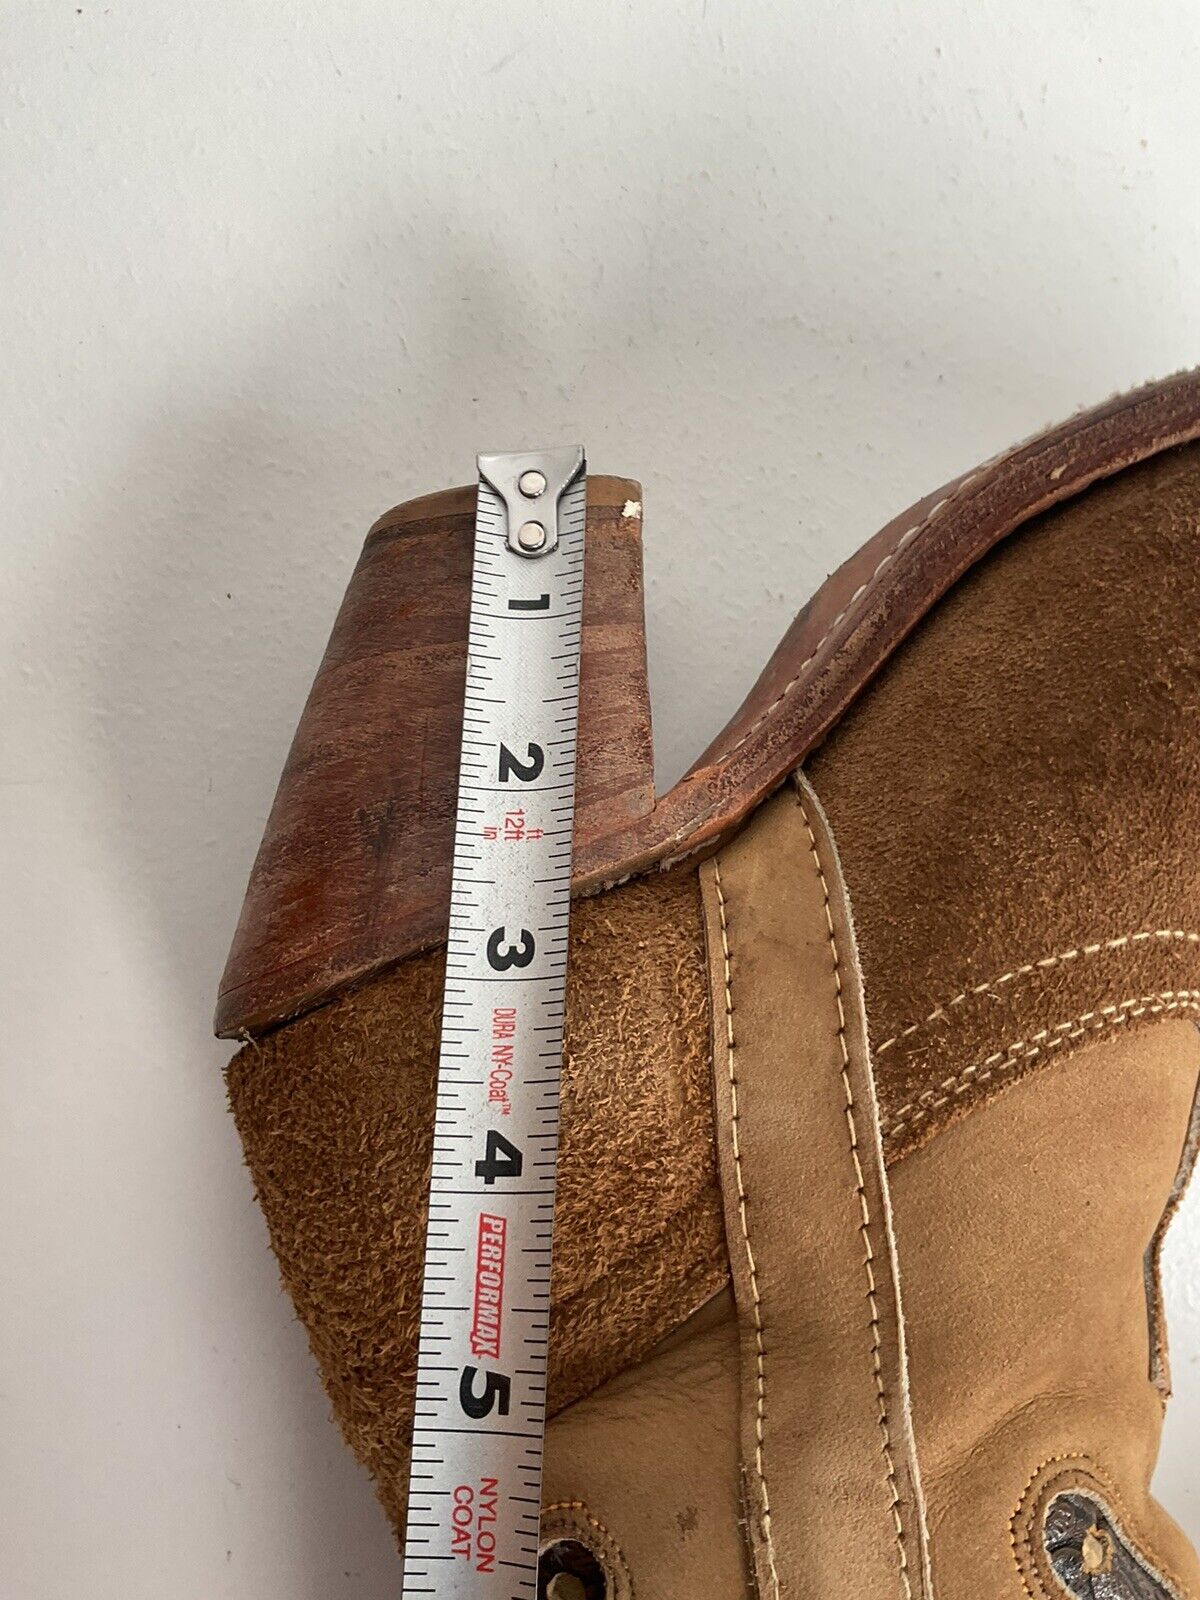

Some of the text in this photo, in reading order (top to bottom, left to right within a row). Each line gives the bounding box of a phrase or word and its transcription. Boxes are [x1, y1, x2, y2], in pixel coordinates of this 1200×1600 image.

[508, 594, 550, 610] 1
[499, 742, 544, 782] 2
[483, 826, 497, 840] in
[504, 808, 525, 841] 12ft
[526, 828, 544, 840] ft
[487, 926, 535, 971] 3
[492, 1008, 517, 1039] DURA
[475, 1130, 523, 1184] 4
[471, 1216, 504, 1356] PERFORMAX
[459, 1365, 511, 1419] 5
[451, 1485, 474, 1561] COAT
[476, 1477, 499, 1573] NYLON
